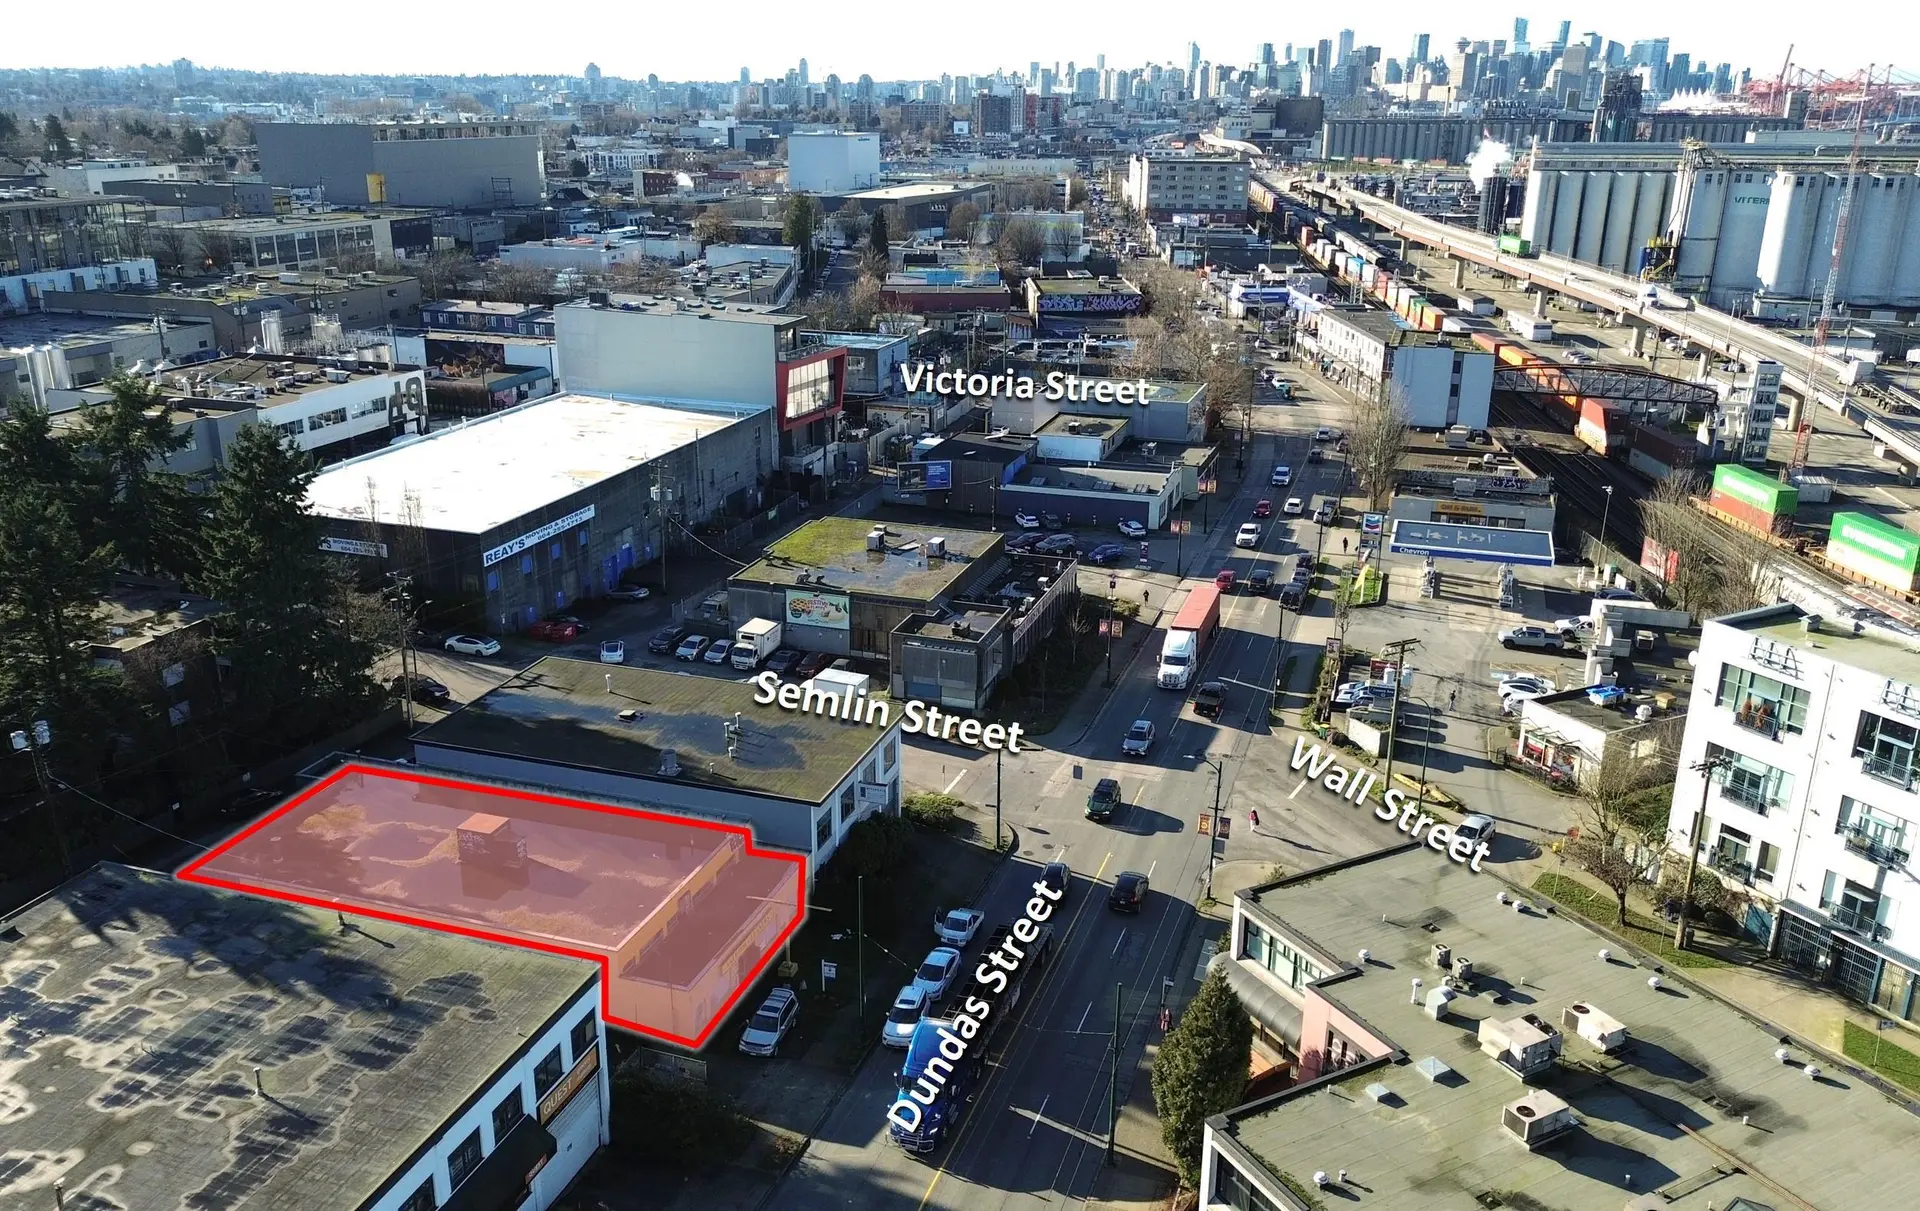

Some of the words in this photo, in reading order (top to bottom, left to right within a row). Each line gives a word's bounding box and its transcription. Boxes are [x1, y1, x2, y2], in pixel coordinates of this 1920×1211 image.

[485, 538, 526, 564] REAY'S
[525, 523, 553, 540] MOVING
[560, 507, 592, 525] STORAGE
[1399, 547, 1430, 556] Chevron
[543, 1076, 573, 1115] QUEST
